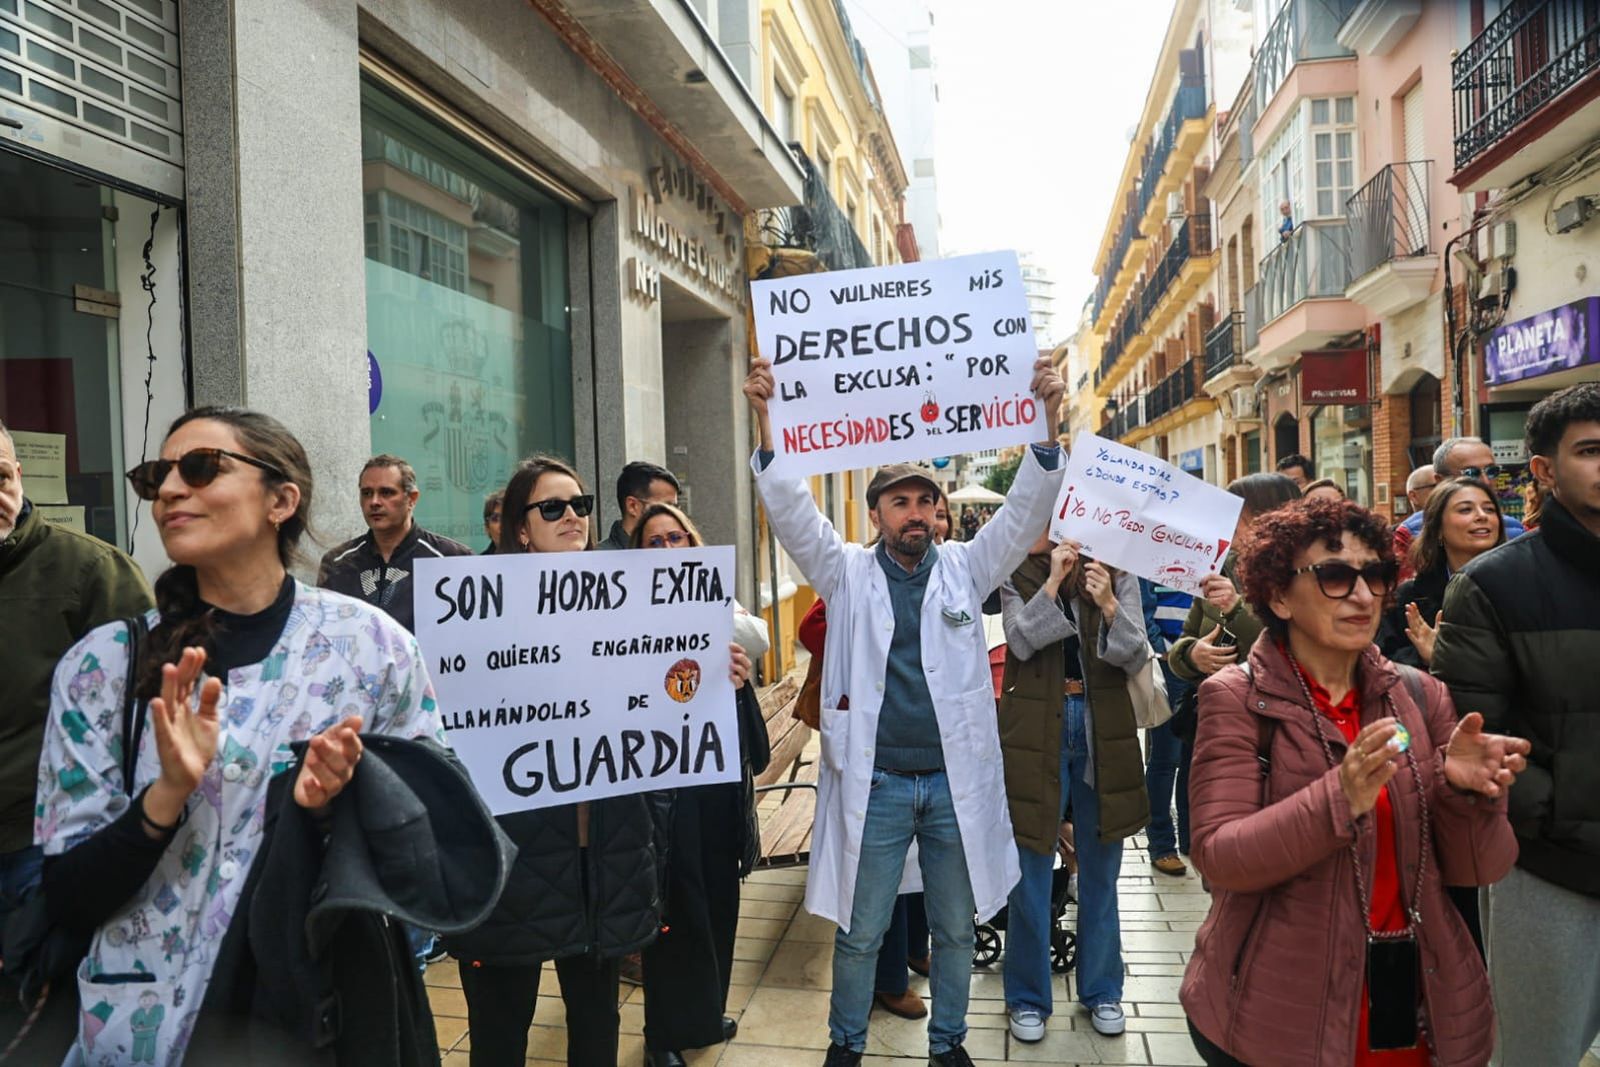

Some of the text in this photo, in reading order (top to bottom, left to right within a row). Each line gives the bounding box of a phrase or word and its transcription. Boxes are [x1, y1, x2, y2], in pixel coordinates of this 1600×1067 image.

[770, 288, 811, 315] NO
[829, 279, 932, 305] VULNERES
[773, 313, 1027, 365] DERECHOS CON
[1498, 317, 1564, 358] PLANETA
[781, 381, 808, 401] LA
[835, 362, 932, 393] EXCUSA:
[927, 428, 942, 436] DEL
[1096, 447, 1145, 473] YOLANDA
[1092, 506, 1112, 526] NO
[434, 561, 731, 624] SON HORAS EXTRA,
[439, 655, 466, 674] NO
[591, 633, 711, 657] ENGAÑARNOS
[442, 694, 649, 731] LLAMÁNDOLAS DE
